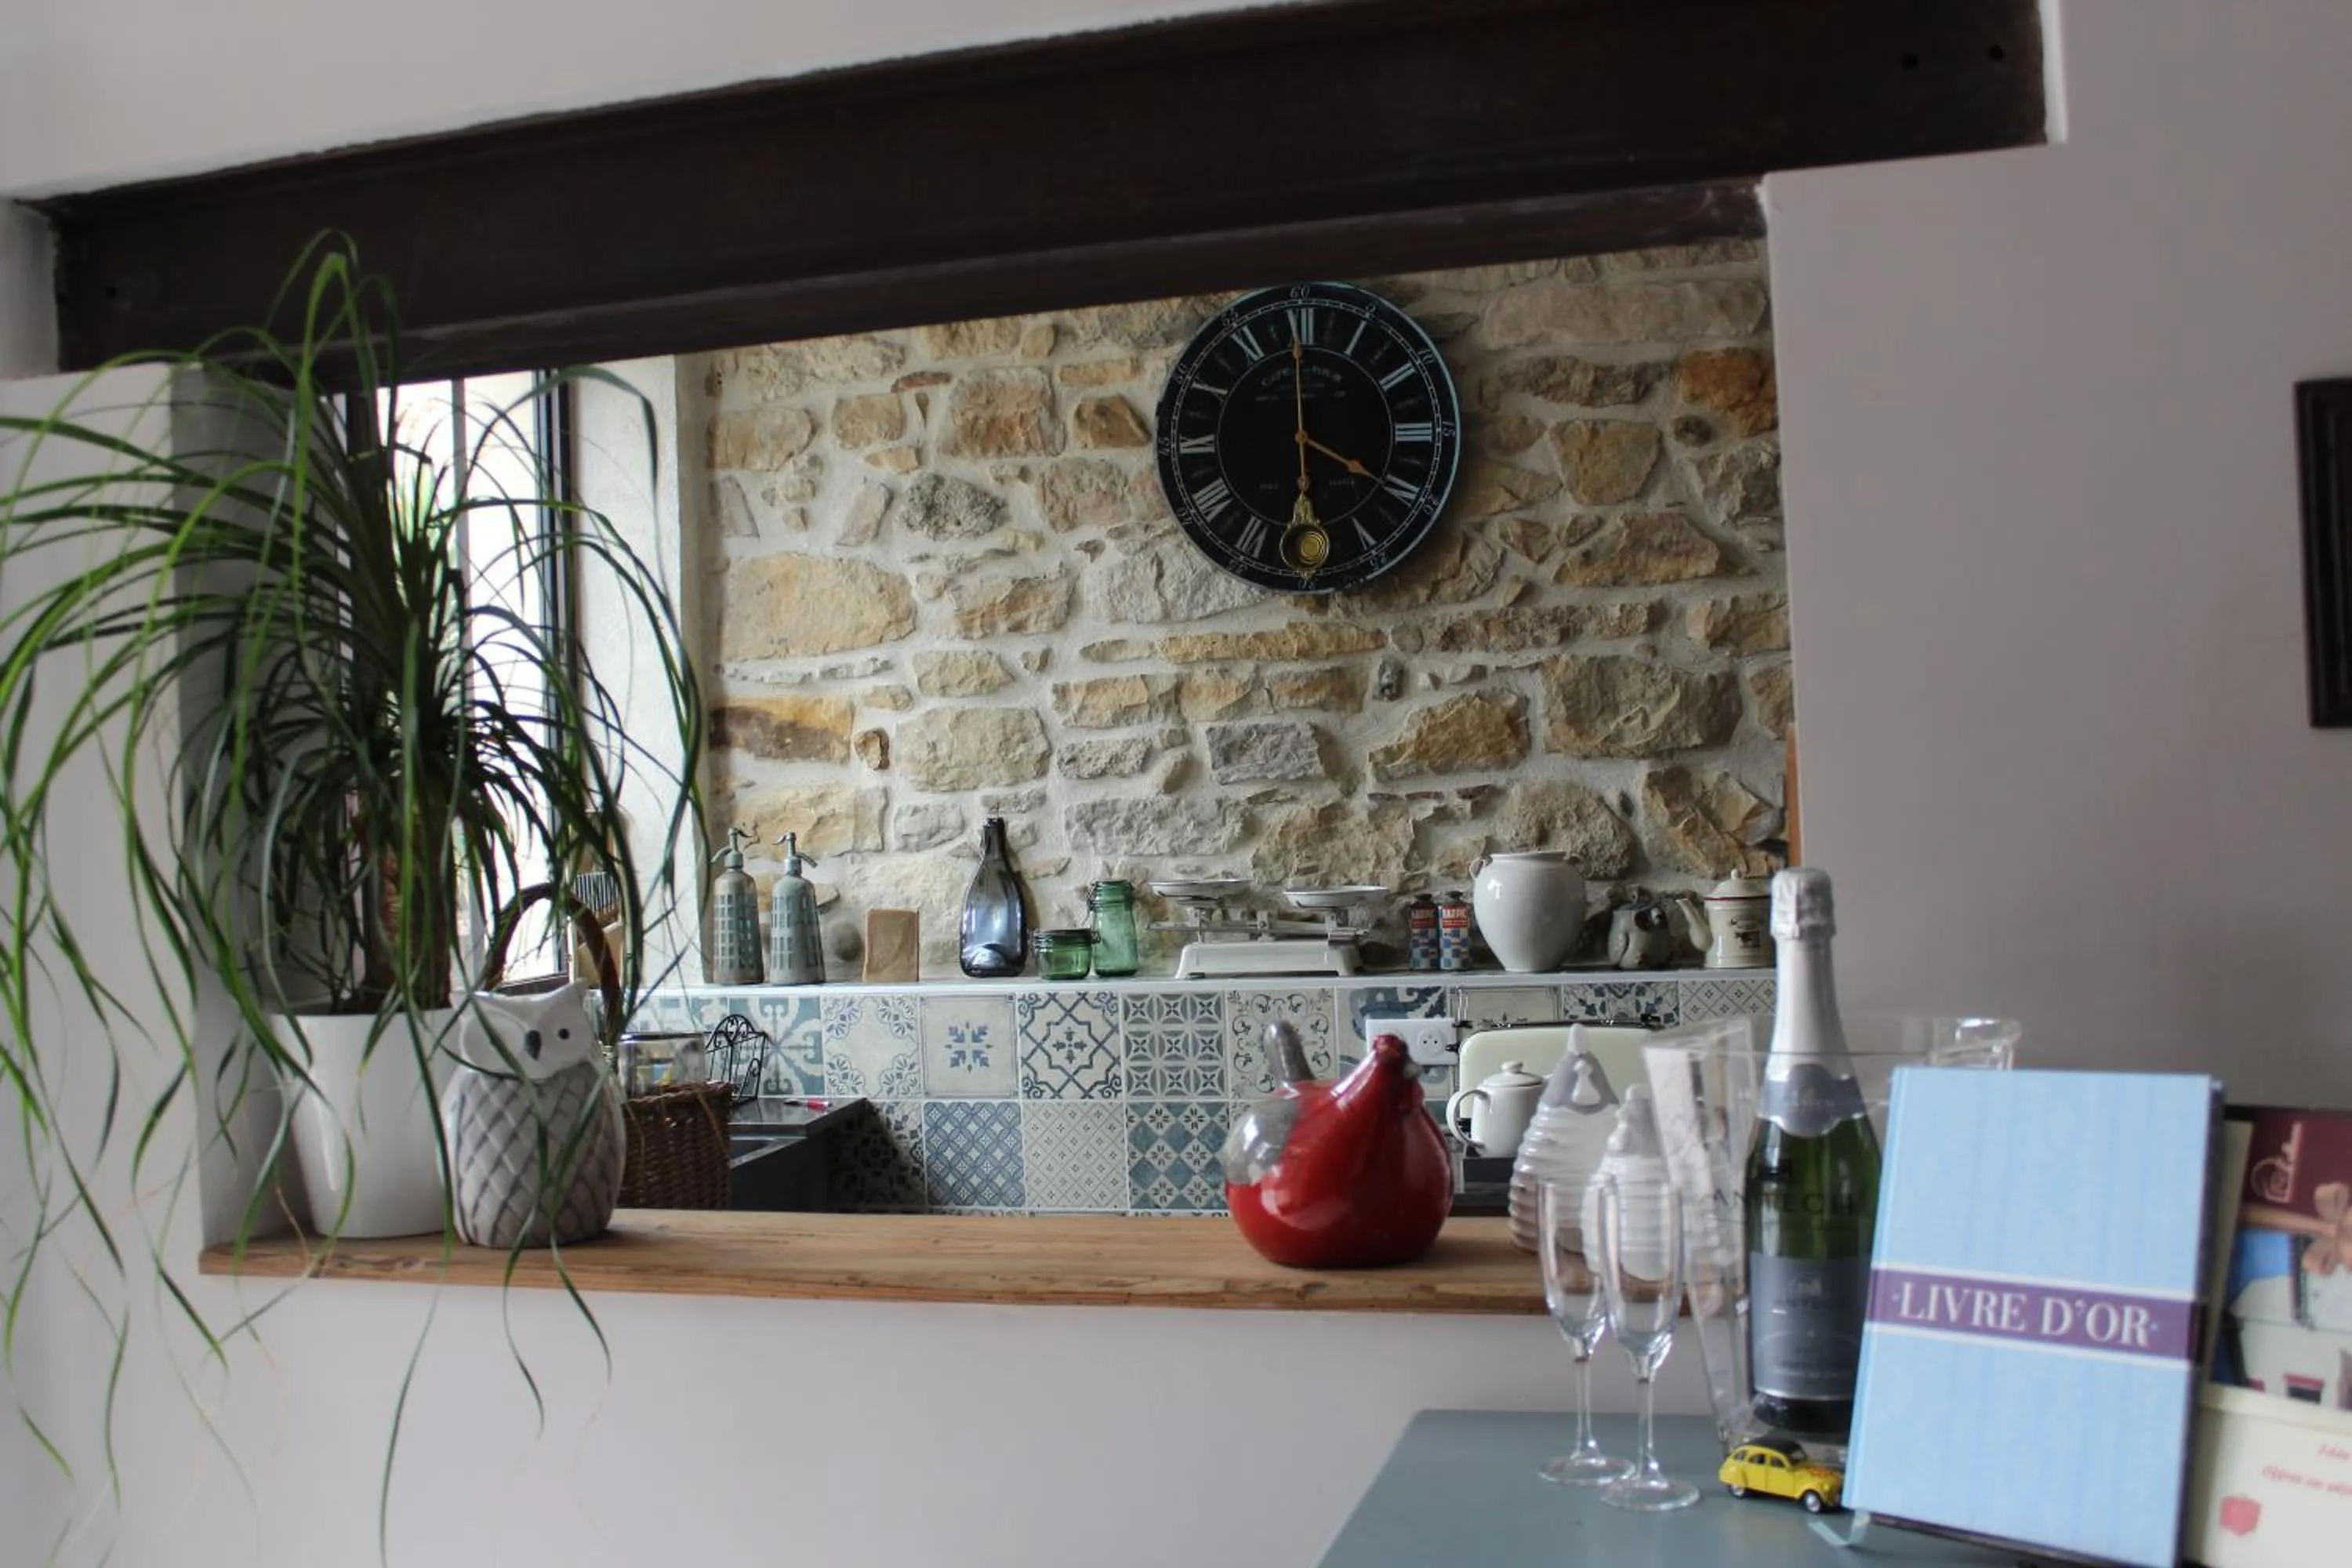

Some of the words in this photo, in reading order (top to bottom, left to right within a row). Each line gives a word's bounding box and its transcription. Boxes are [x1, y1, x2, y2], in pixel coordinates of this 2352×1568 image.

[1290, 286, 1310, 299] 60
[1287, 307, 1316, 345] XII
[1231, 325, 1265, 365] XI
[1417, 349, 1435, 365] 10
[1191, 376, 1228, 401] X
[1379, 362, 1417, 391] II
[1395, 422, 1432, 442] III
[1442, 420, 1456, 437] 15
[1179, 434, 1215, 455] IX
[1191, 478, 1234, 523] VIII
[1383, 474, 1422, 506] IV
[1235, 517, 1269, 557] VII
[1352, 517, 1378, 552] V
[1899, 1281, 2027, 1332] LIVRE
[2041, 1296, 2151, 1347] D'OR
